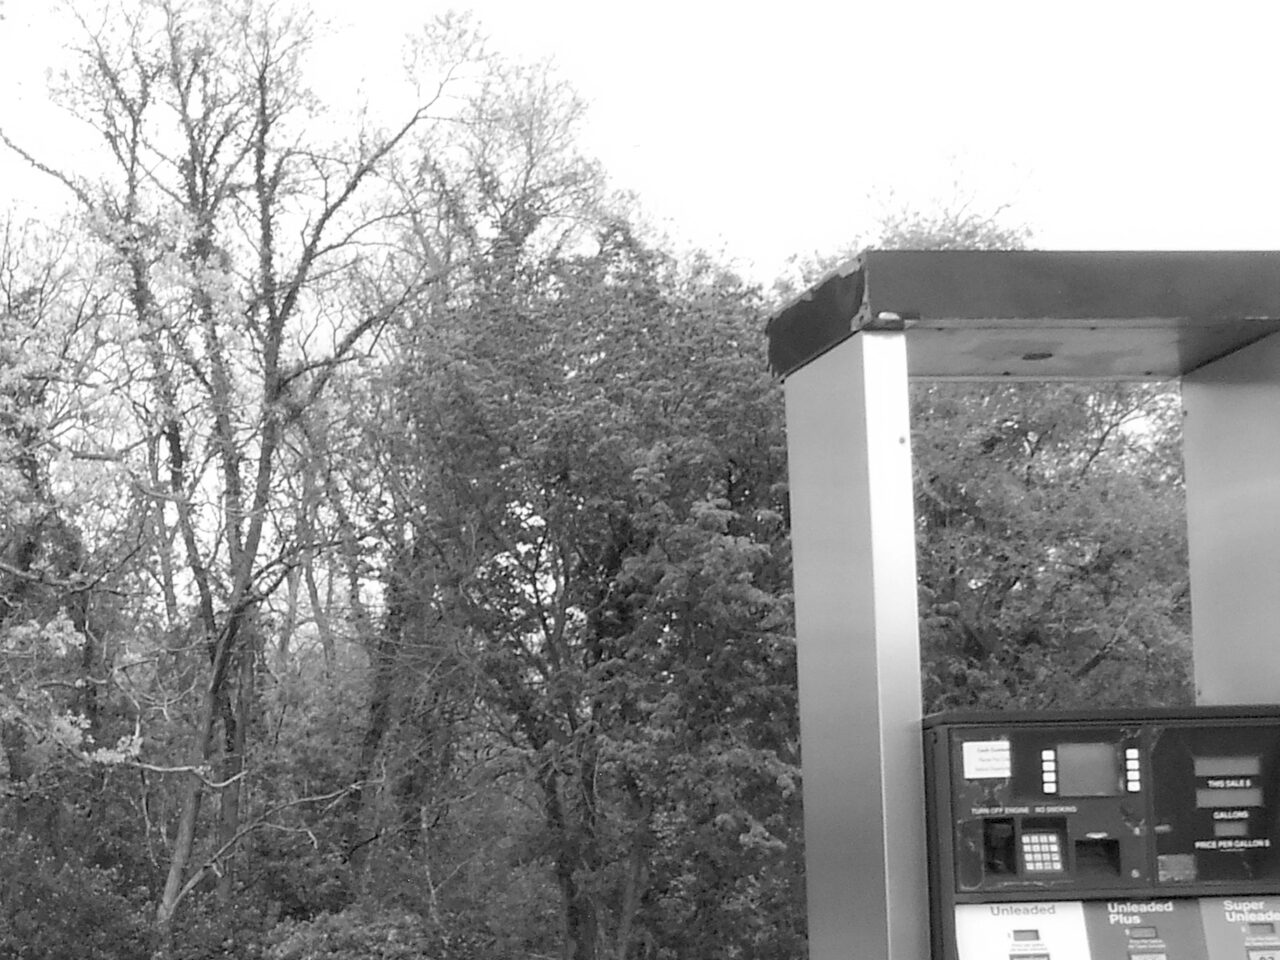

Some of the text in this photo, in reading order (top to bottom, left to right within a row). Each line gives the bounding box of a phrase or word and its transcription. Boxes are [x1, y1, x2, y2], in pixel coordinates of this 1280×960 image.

[1207, 780, 1224, 788] THIS
[1005, 806, 1029, 814] ENGINE
[1213, 811, 1249, 819] GALLONS
[1195, 841, 1217, 849] PRICE
[1218, 840, 1233, 848] PER
[1234, 840, 1264, 848] GALLON
[990, 904, 1056, 916] Unleaded
[1107, 901, 1173, 912] Unleaded
[1223, 900, 1265, 912] Super
[1109, 913, 1141, 924] Plus
